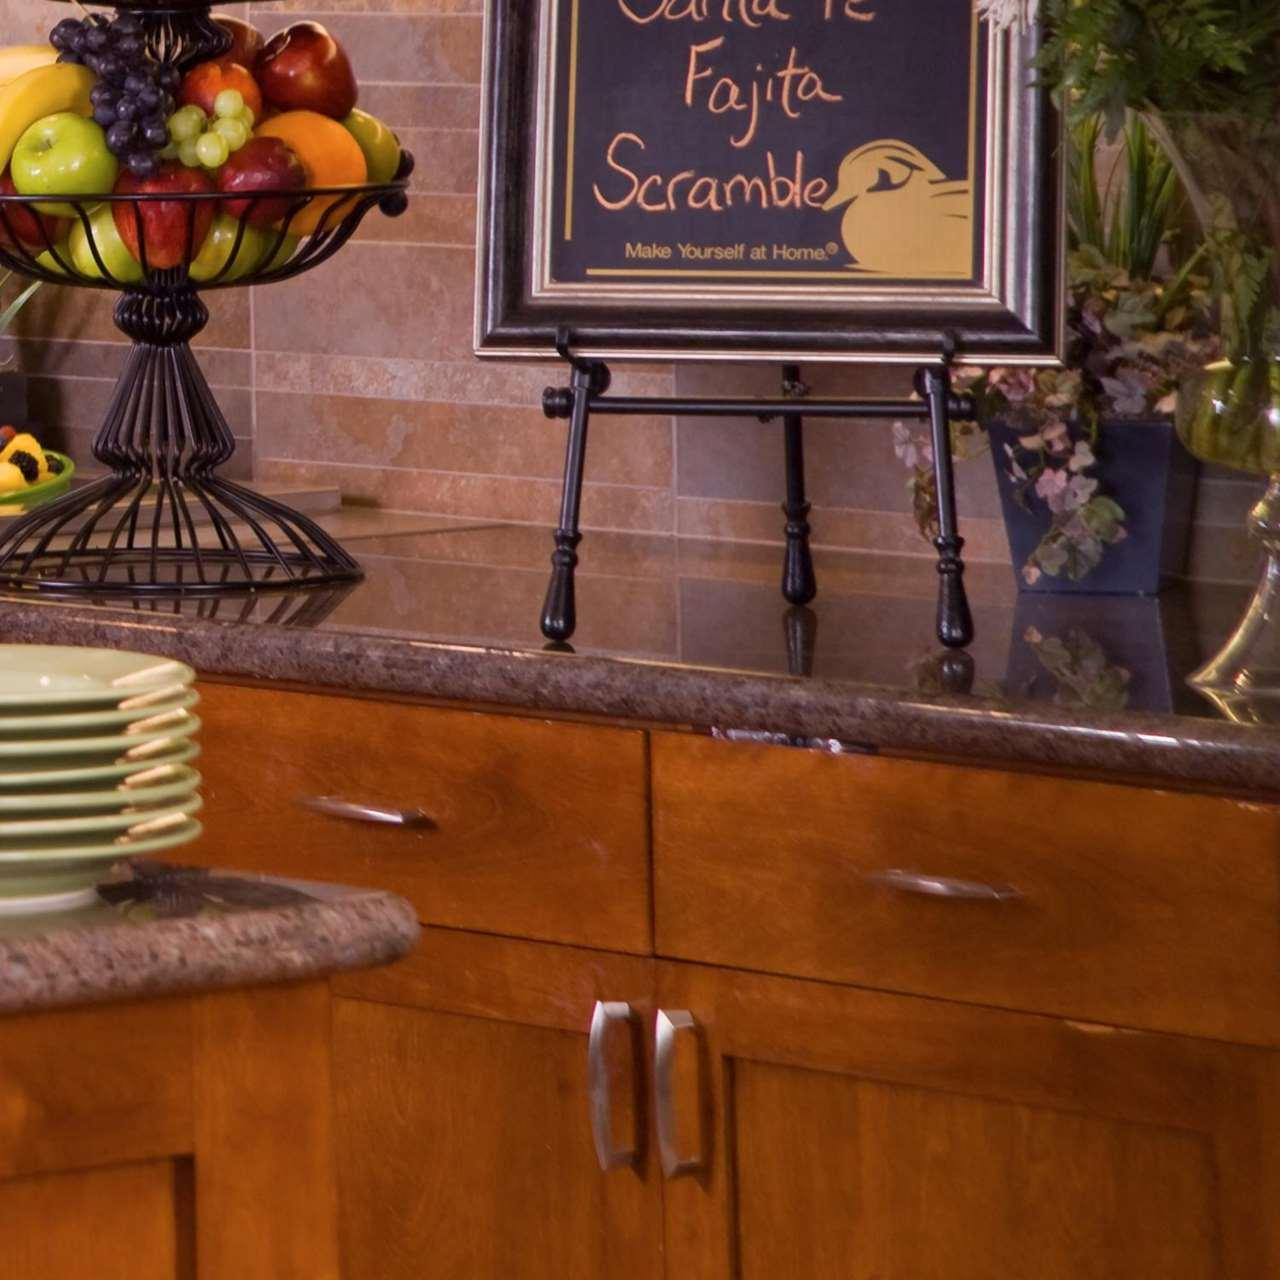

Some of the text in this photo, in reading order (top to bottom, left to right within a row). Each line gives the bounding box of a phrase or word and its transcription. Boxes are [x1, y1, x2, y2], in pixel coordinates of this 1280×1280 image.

[685, 35, 843, 148] Fajita
[593, 131, 829, 212] Scramble
[624, 242, 672, 261] Make
[677, 242, 745, 261] Yourself
[750, 244, 767, 261] at
